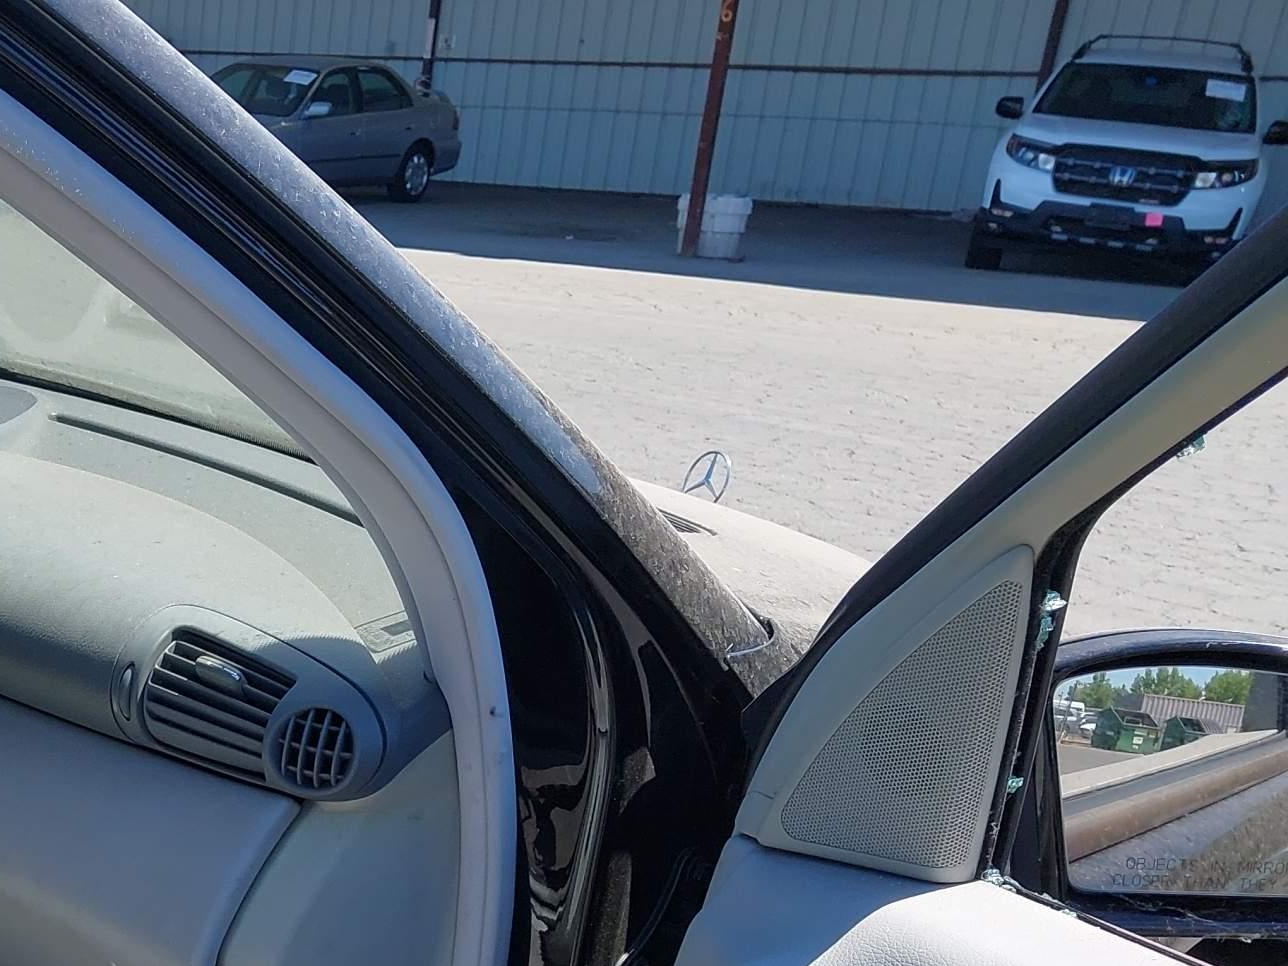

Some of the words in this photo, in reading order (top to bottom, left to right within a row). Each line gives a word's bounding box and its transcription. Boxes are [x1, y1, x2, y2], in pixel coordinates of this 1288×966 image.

[1125, 856, 1200, 873] OBJECTS
[1210, 860, 1225, 873] IN
[1238, 861, 1288, 875] MIRRO
[1111, 873, 1176, 890] CLOSER
[1183, 875, 1226, 891] THAN
[1240, 877, 1279, 891] THEY
